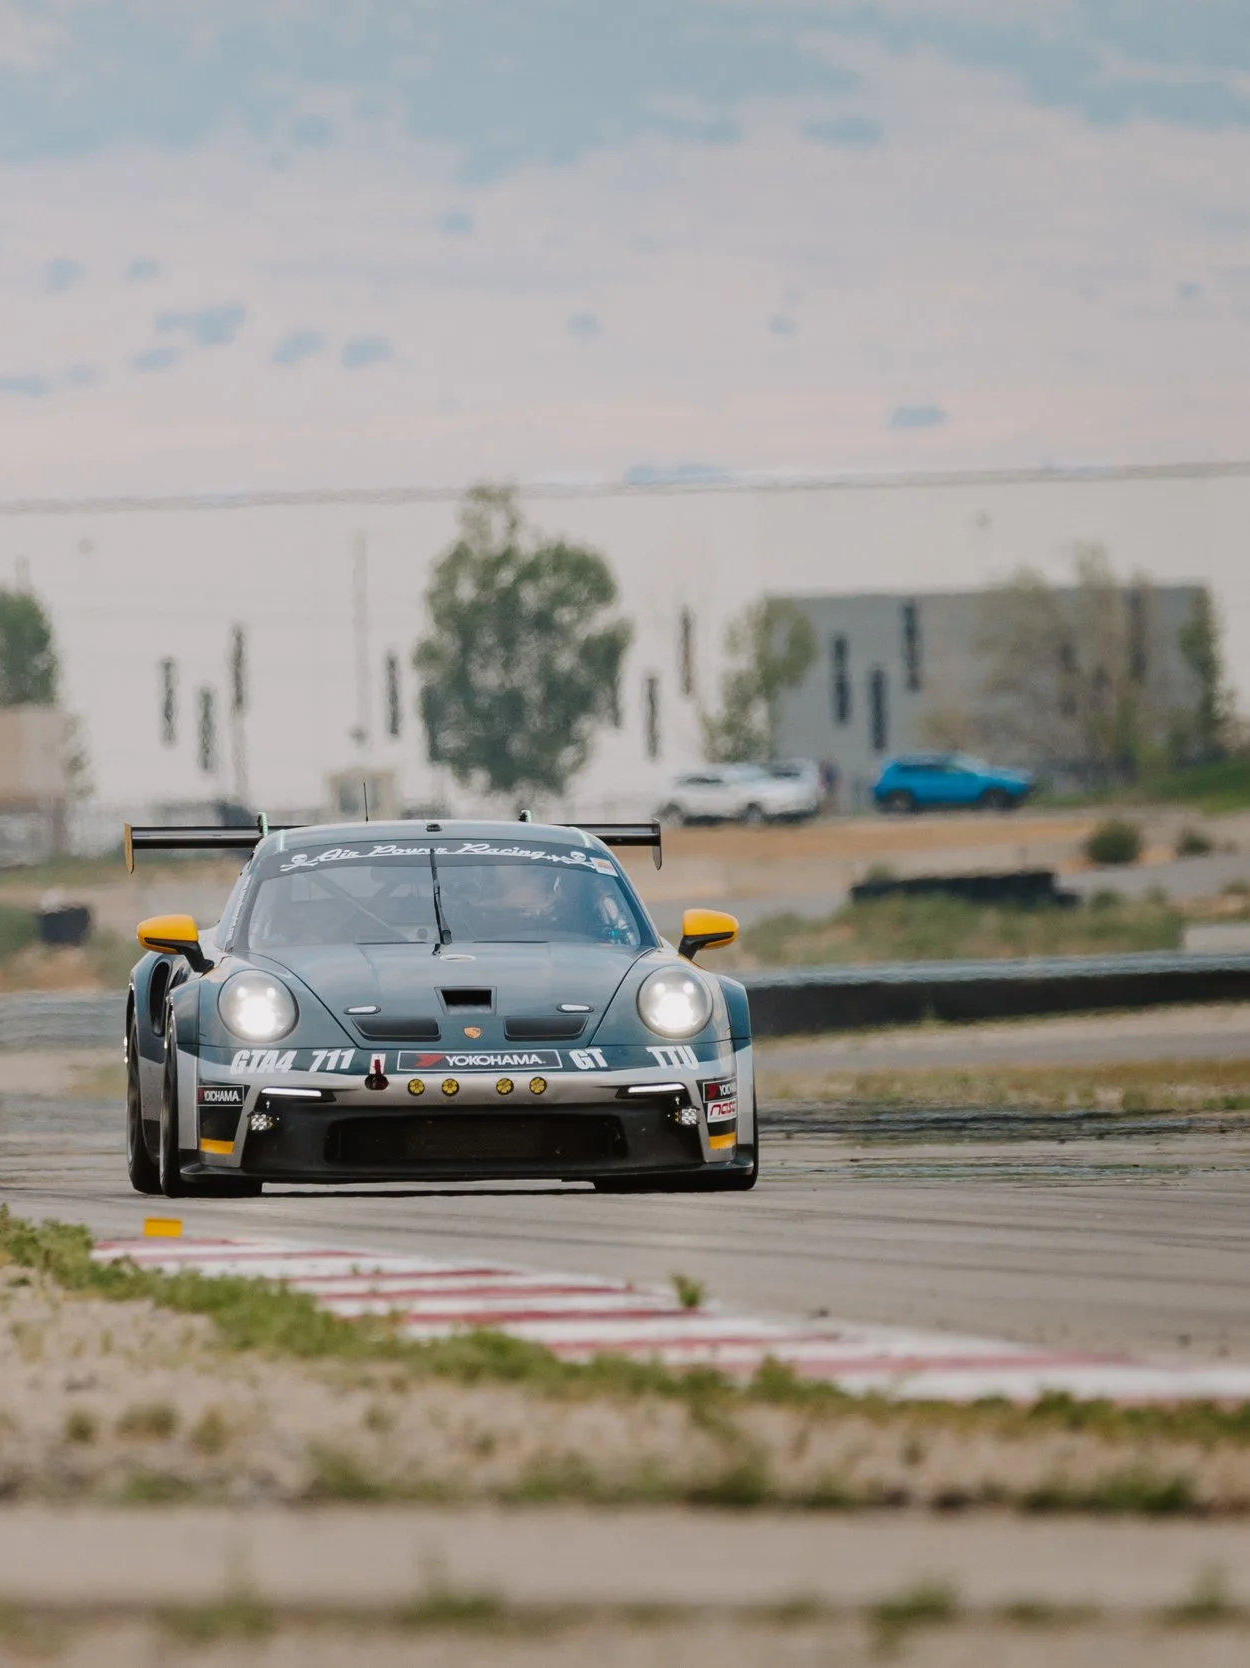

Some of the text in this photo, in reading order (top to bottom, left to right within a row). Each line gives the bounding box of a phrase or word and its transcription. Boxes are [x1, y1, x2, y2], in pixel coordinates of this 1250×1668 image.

[316, 848, 360, 862] Air
[455, 843, 546, 860] Racing
[230, 1049, 356, 1075] GTA4 711
[445, 1053, 543, 1067] YOKOHAMA
[569, 1048, 609, 1070] GT
[646, 1045, 700, 1070] TTU
